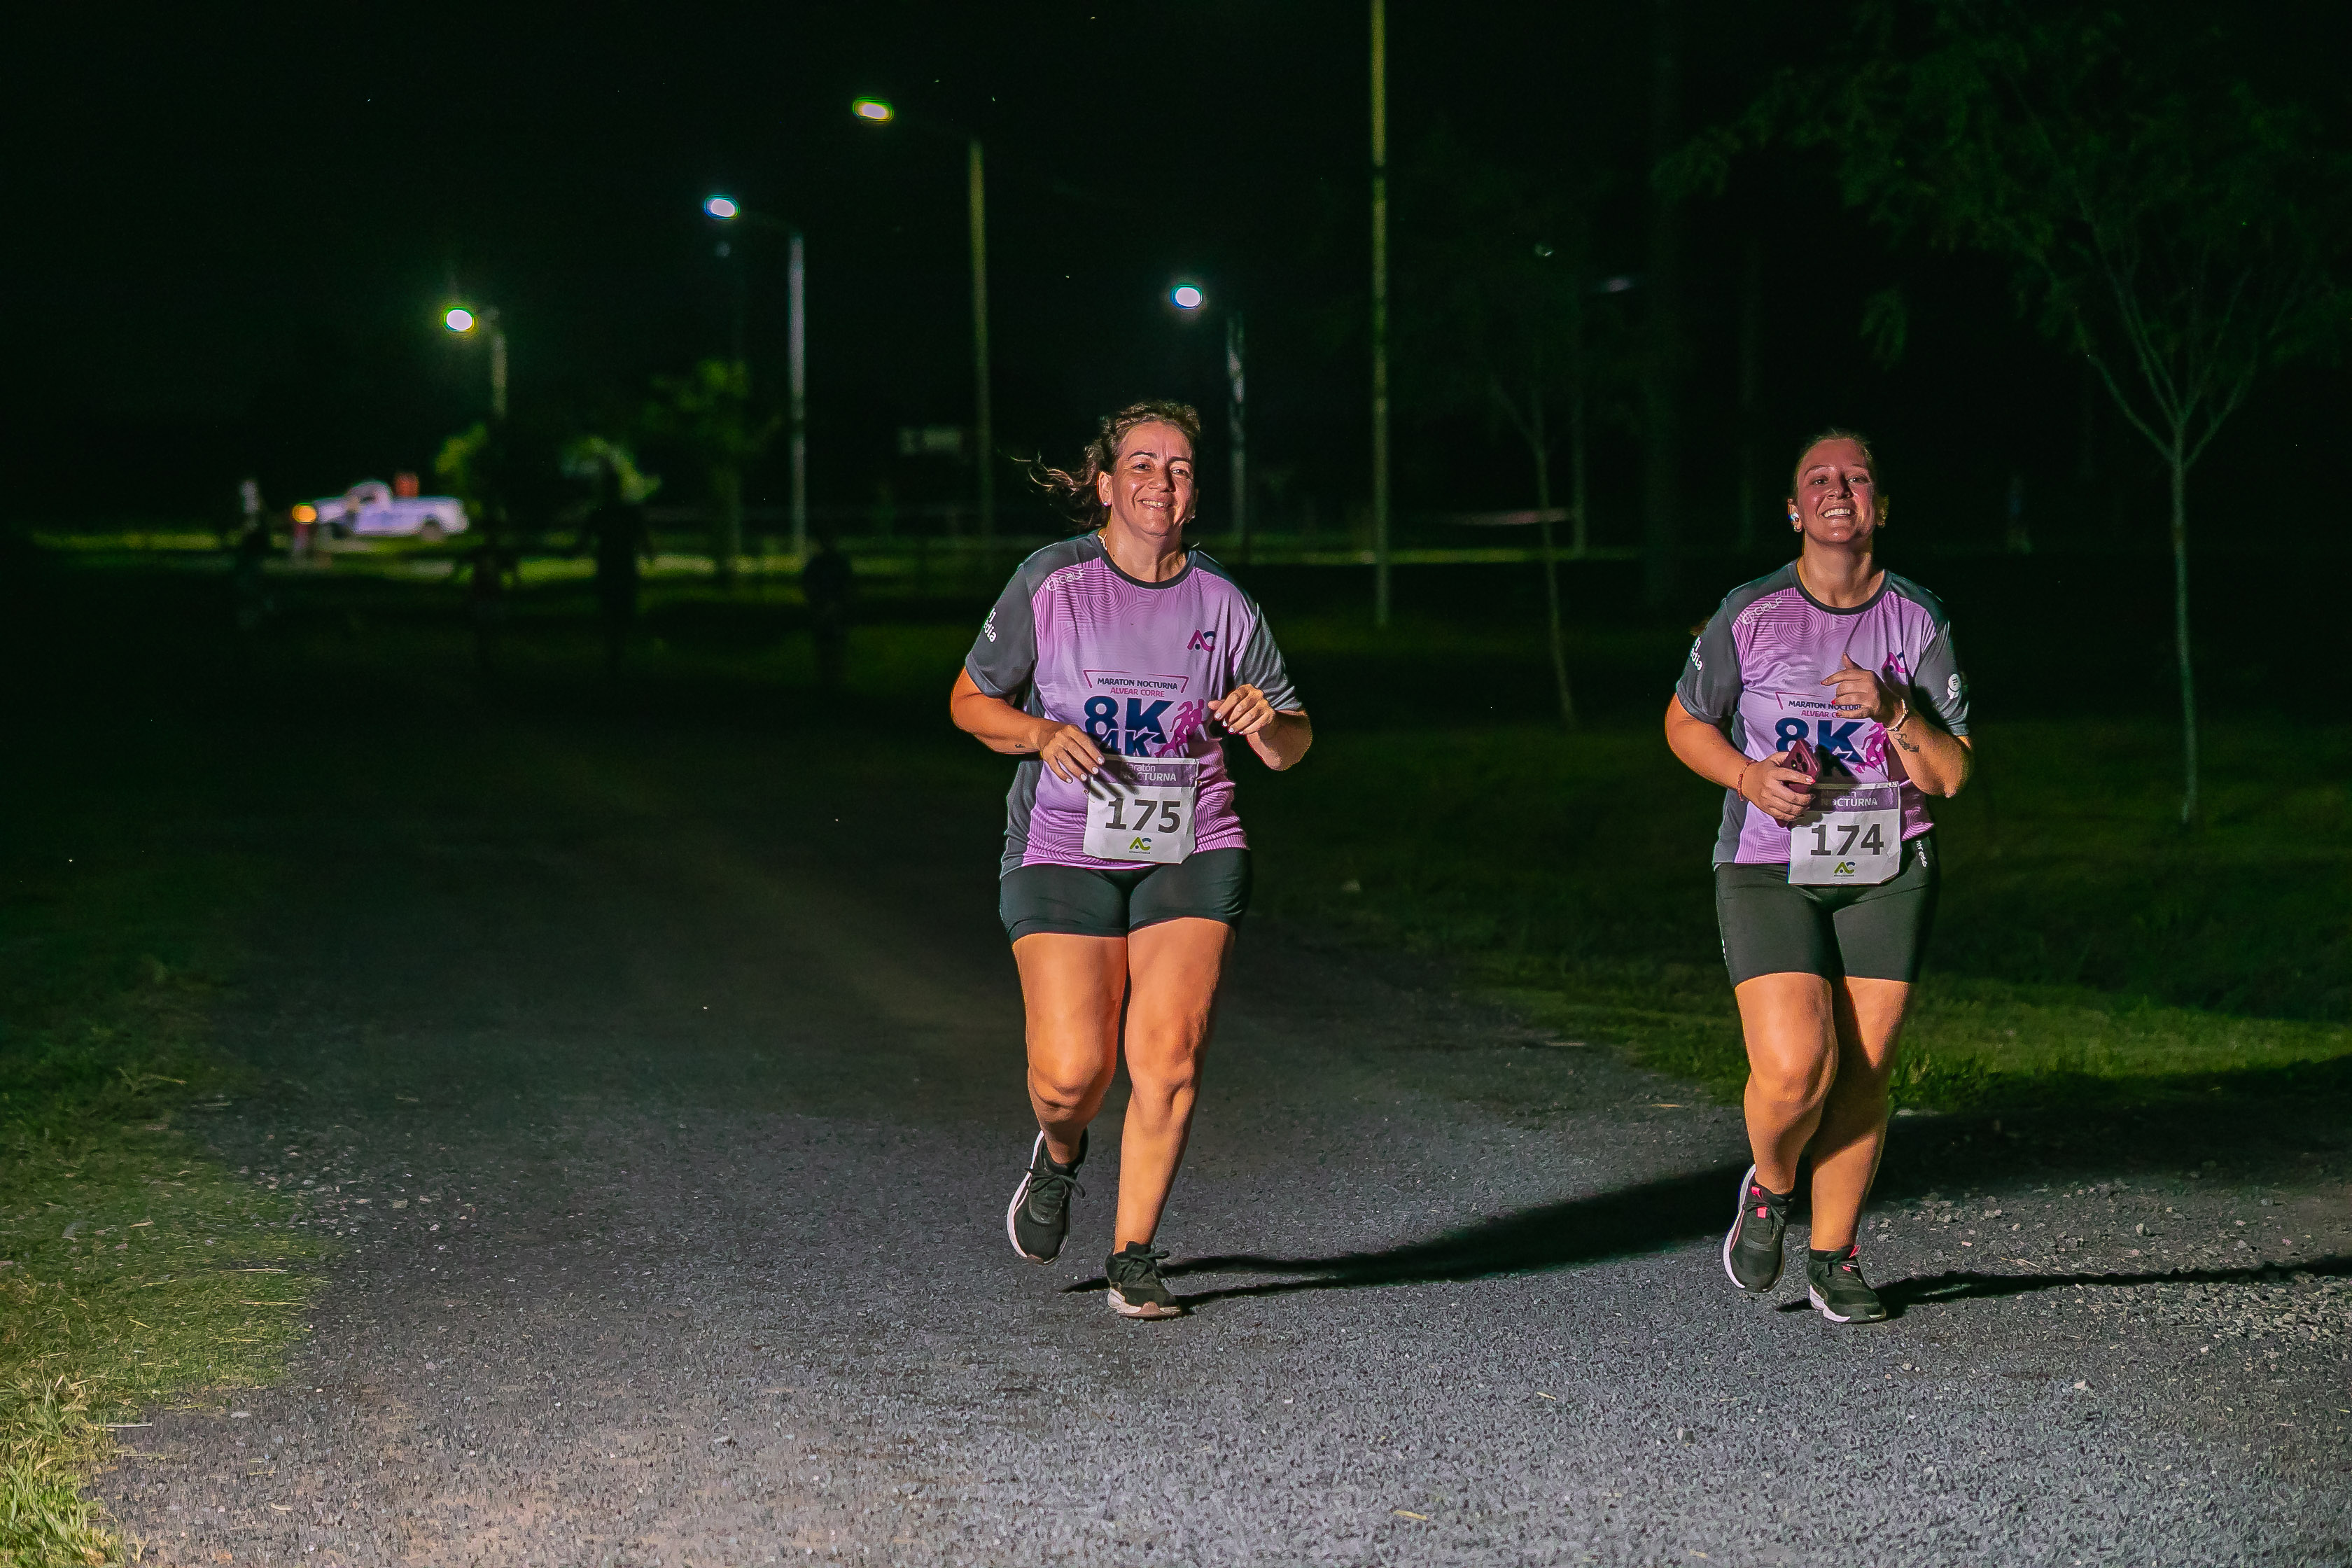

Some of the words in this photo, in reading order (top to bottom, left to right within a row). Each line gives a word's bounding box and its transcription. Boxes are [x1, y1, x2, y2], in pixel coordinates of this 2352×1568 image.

[1097, 678, 1135, 687] MARATON
[1137, 680, 1178, 690] NOCTURNA
[1110, 687, 1139, 695] ALVEAR
[1140, 689, 1165, 697] CORRE
[1788, 700, 1826, 709] MARATON
[1084, 695, 1175, 744] 8K
[1127, 762, 1156, 772] aratón
[1105, 797, 1181, 834] 175
[1810, 823, 1884, 855] 174
